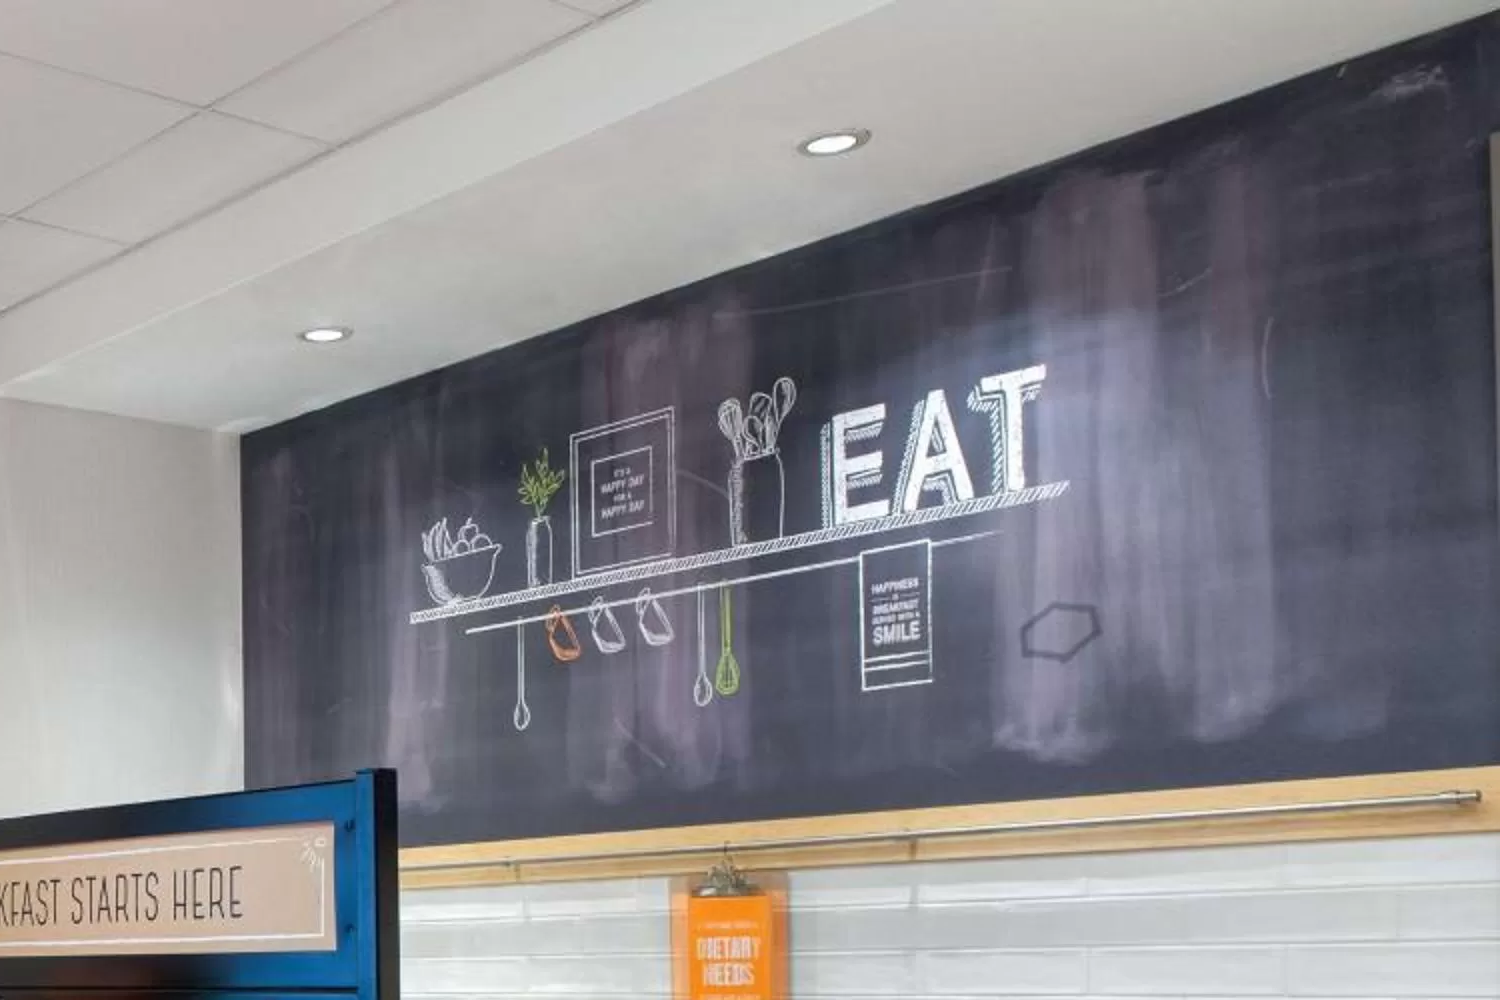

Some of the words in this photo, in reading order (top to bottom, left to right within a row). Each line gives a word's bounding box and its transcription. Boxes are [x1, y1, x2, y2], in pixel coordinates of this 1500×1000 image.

[820, 363, 1047, 529] EAT
[872, 619, 921, 647] SMILE
[71, 870, 159, 925] STARTS
[173, 865, 243, 921] HERE
